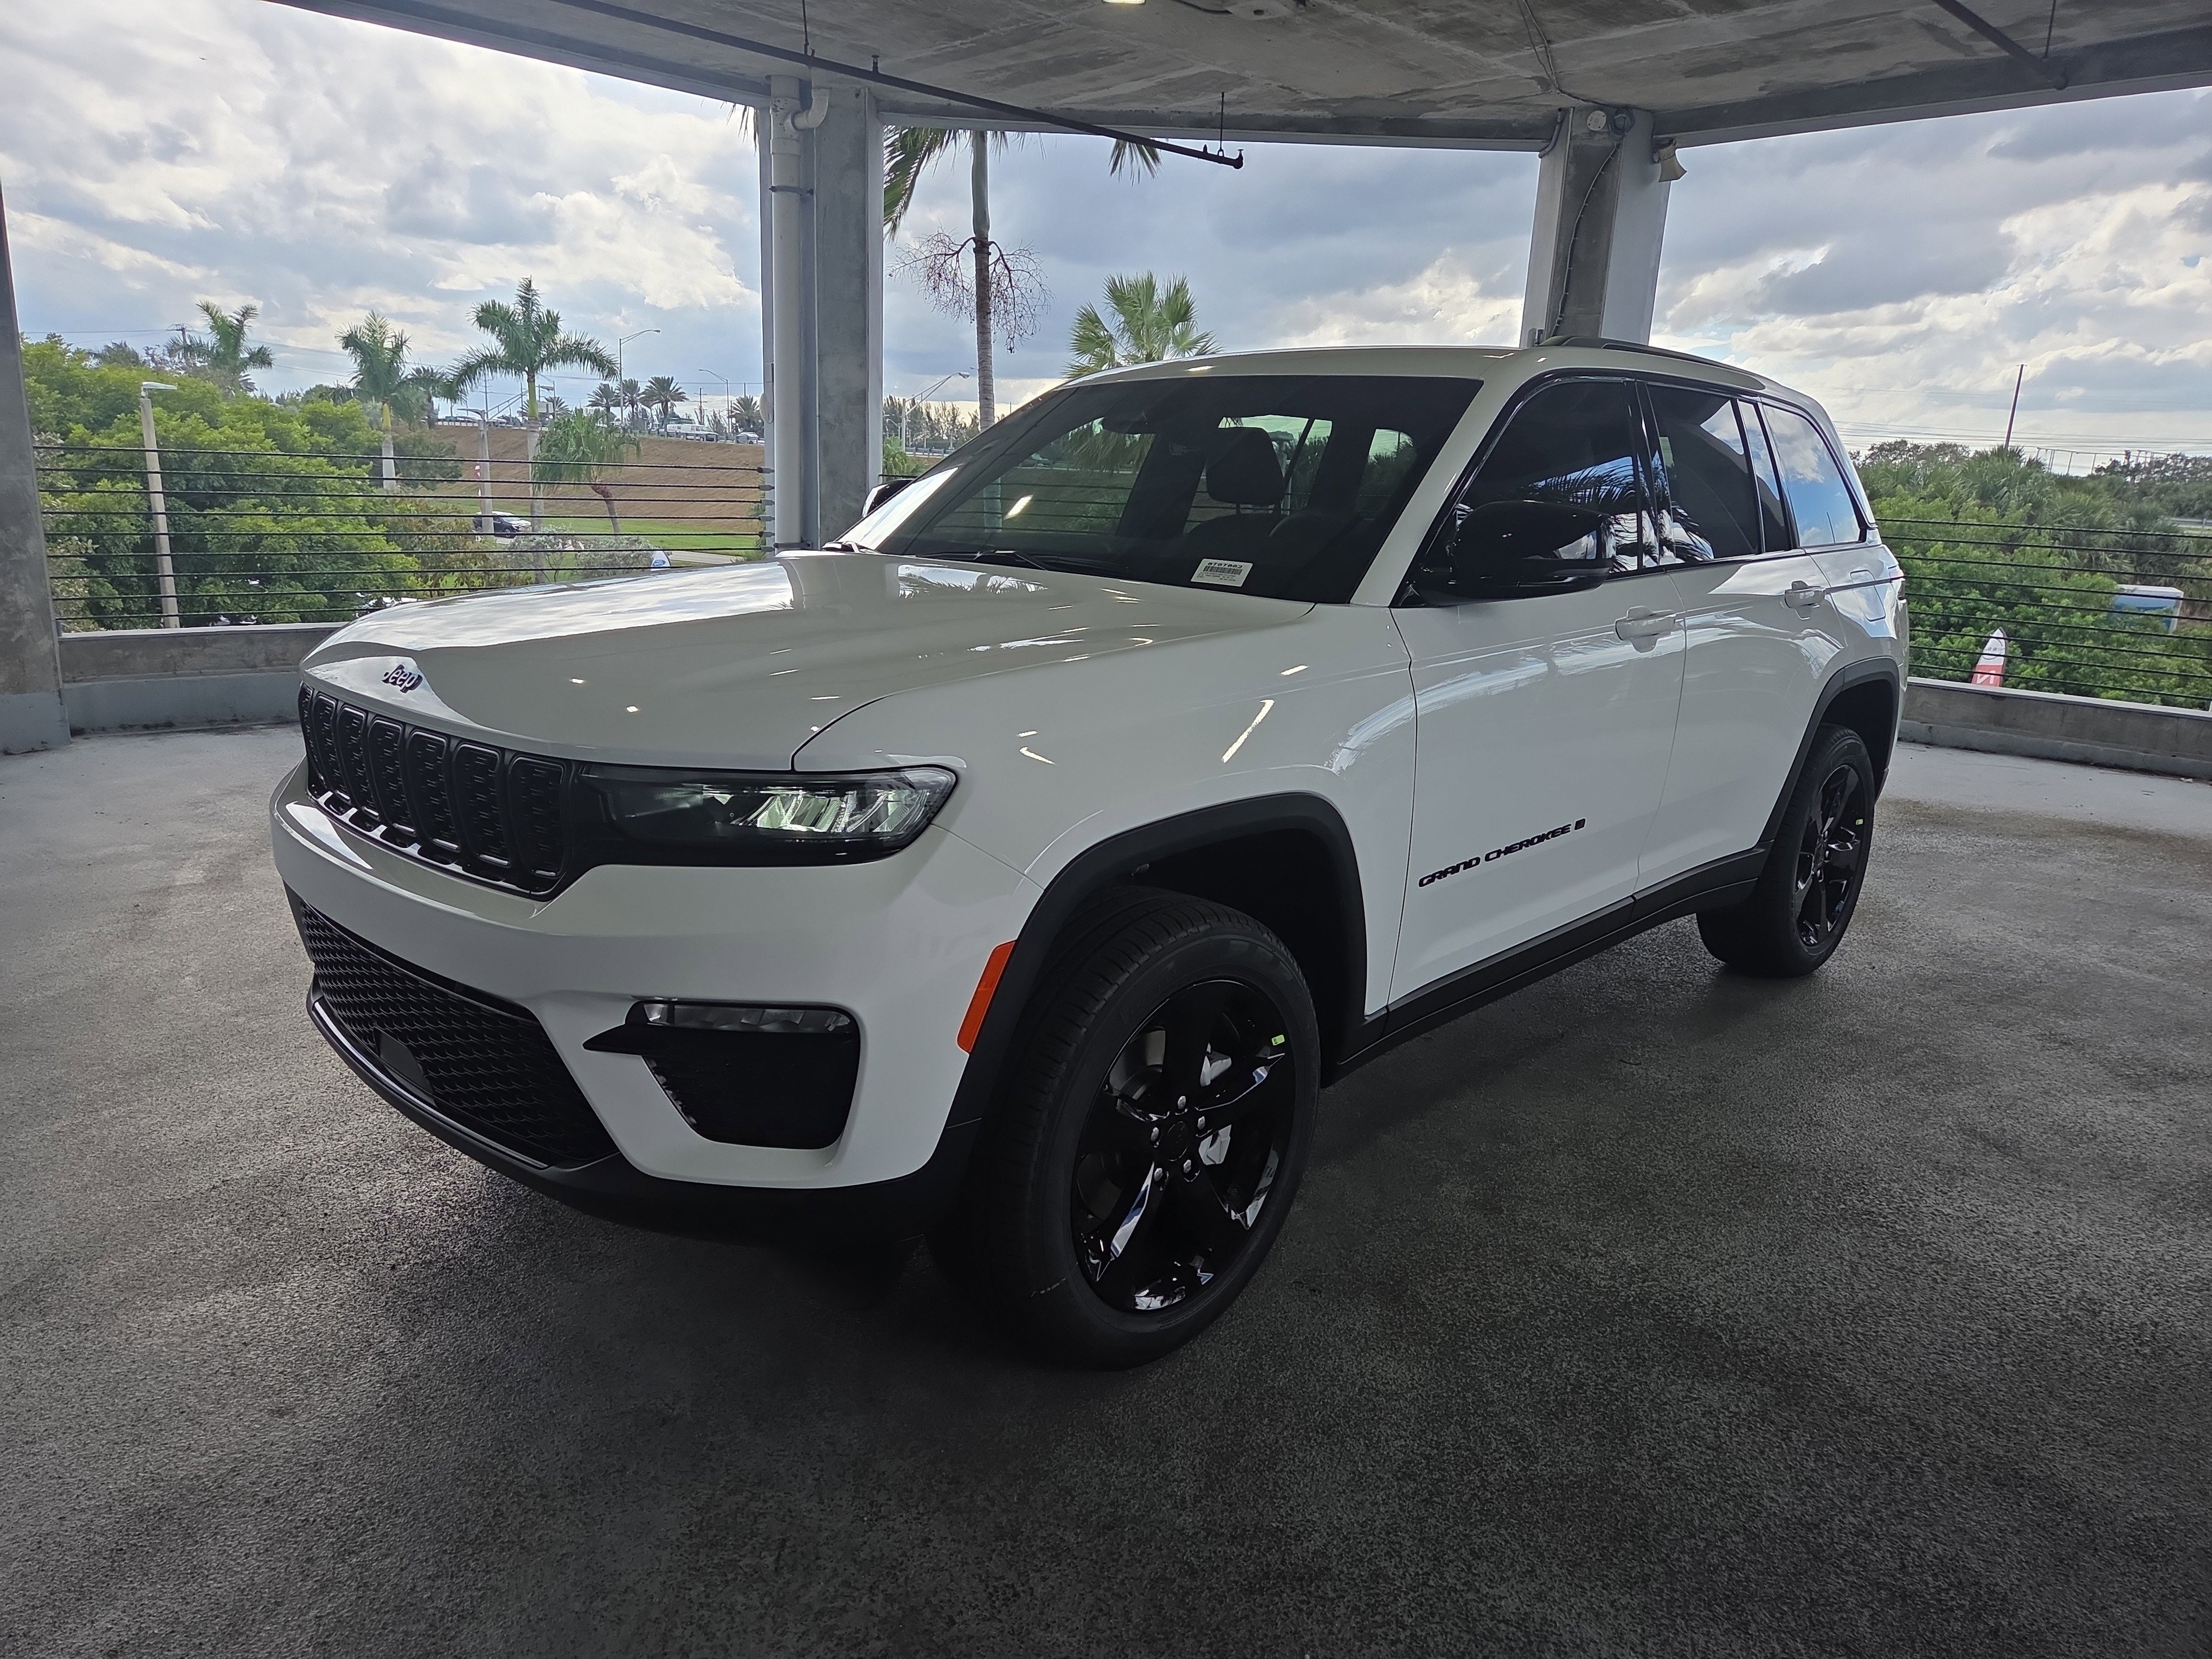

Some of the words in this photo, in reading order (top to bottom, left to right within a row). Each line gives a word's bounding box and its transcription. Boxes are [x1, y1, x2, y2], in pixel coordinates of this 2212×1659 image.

[381, 664, 423, 693] Jeep
[1419, 857, 1481, 888] GRAND
[1484, 824, 1572, 862] CHEROKEE
